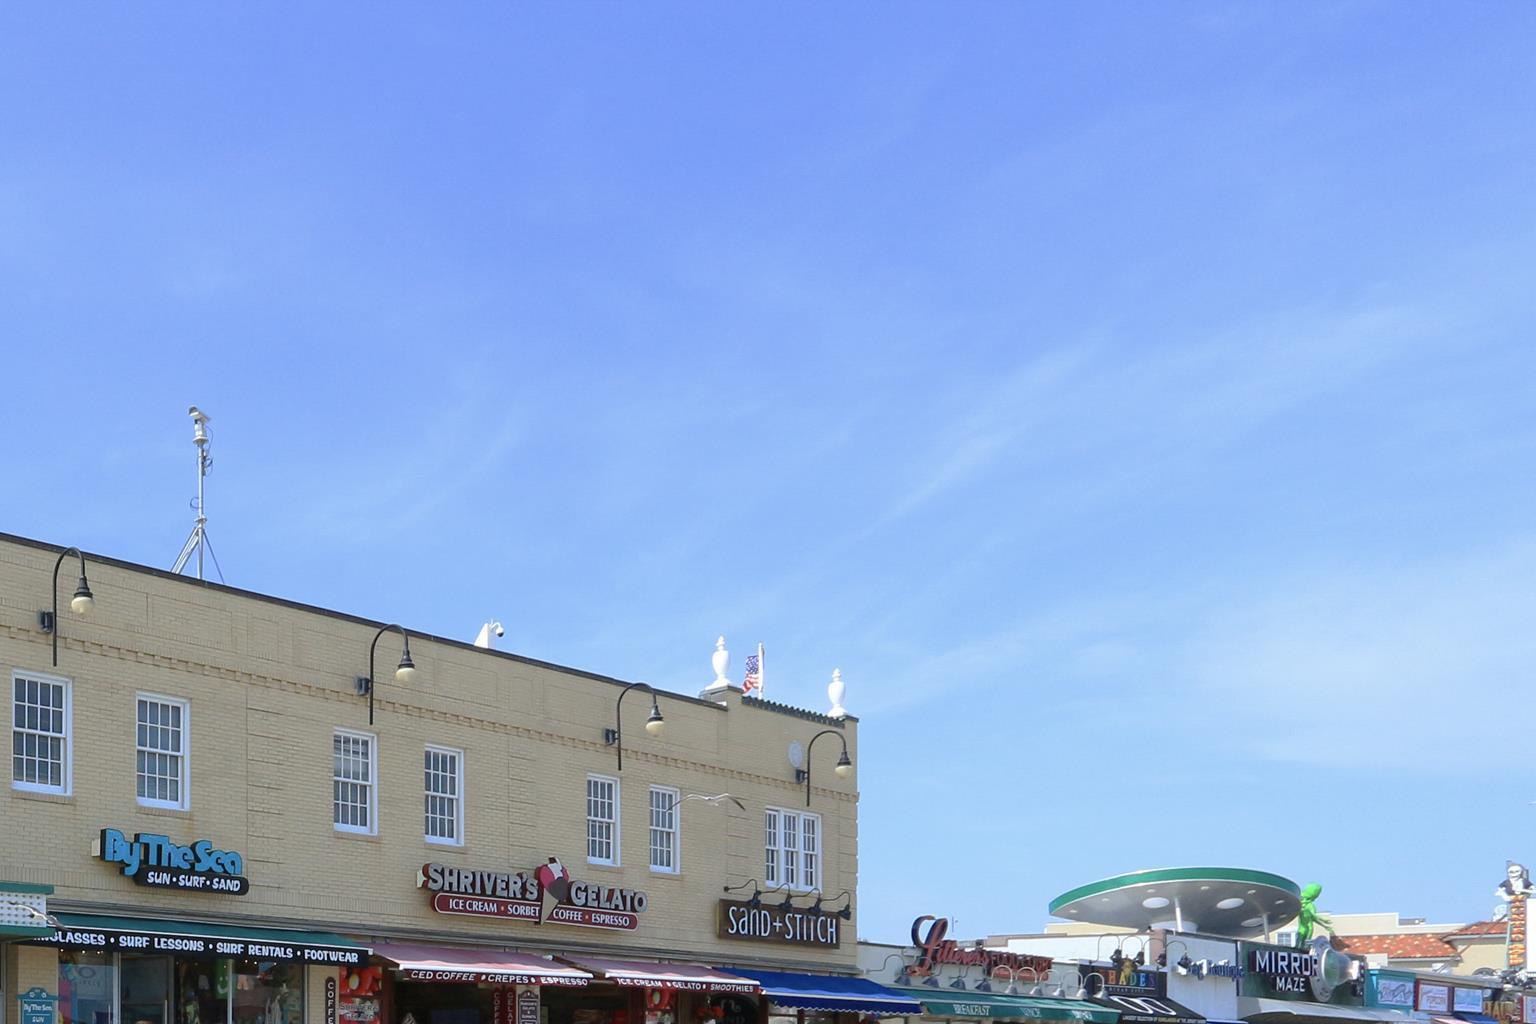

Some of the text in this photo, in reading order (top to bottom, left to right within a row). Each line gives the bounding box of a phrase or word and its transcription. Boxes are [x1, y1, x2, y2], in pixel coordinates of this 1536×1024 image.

[104, 828, 243, 877] By The Sea
[147, 871, 241, 892] SUN SURF SAND
[427, 862, 649, 913] SHRIVER'S GELATO
[449, 899, 630, 928] ICE CREAM SORBET COFFEE ESPRESSO
[119, 935, 150, 948] SURF
[154, 937, 204, 952] LESSONS
[216, 942, 245, 955] SURF
[248, 944, 293, 959] RENTALS
[304, 949, 359, 963] FOOTWEAR
[1256, 950, 1318, 976] MIRROR
[436, 971, 476, 981] COFFEE
[488, 974, 529, 984] CREPES
[540, 976, 588, 986] ESPRESSO
[634, 979, 663, 987] CREAM
[672, 981, 701, 990] GELATO
[710, 983, 754, 992] SMOOTHIES
[1276, 976, 1305, 992] MAZE
[953, 1004, 991, 1016] BREAKFAST
